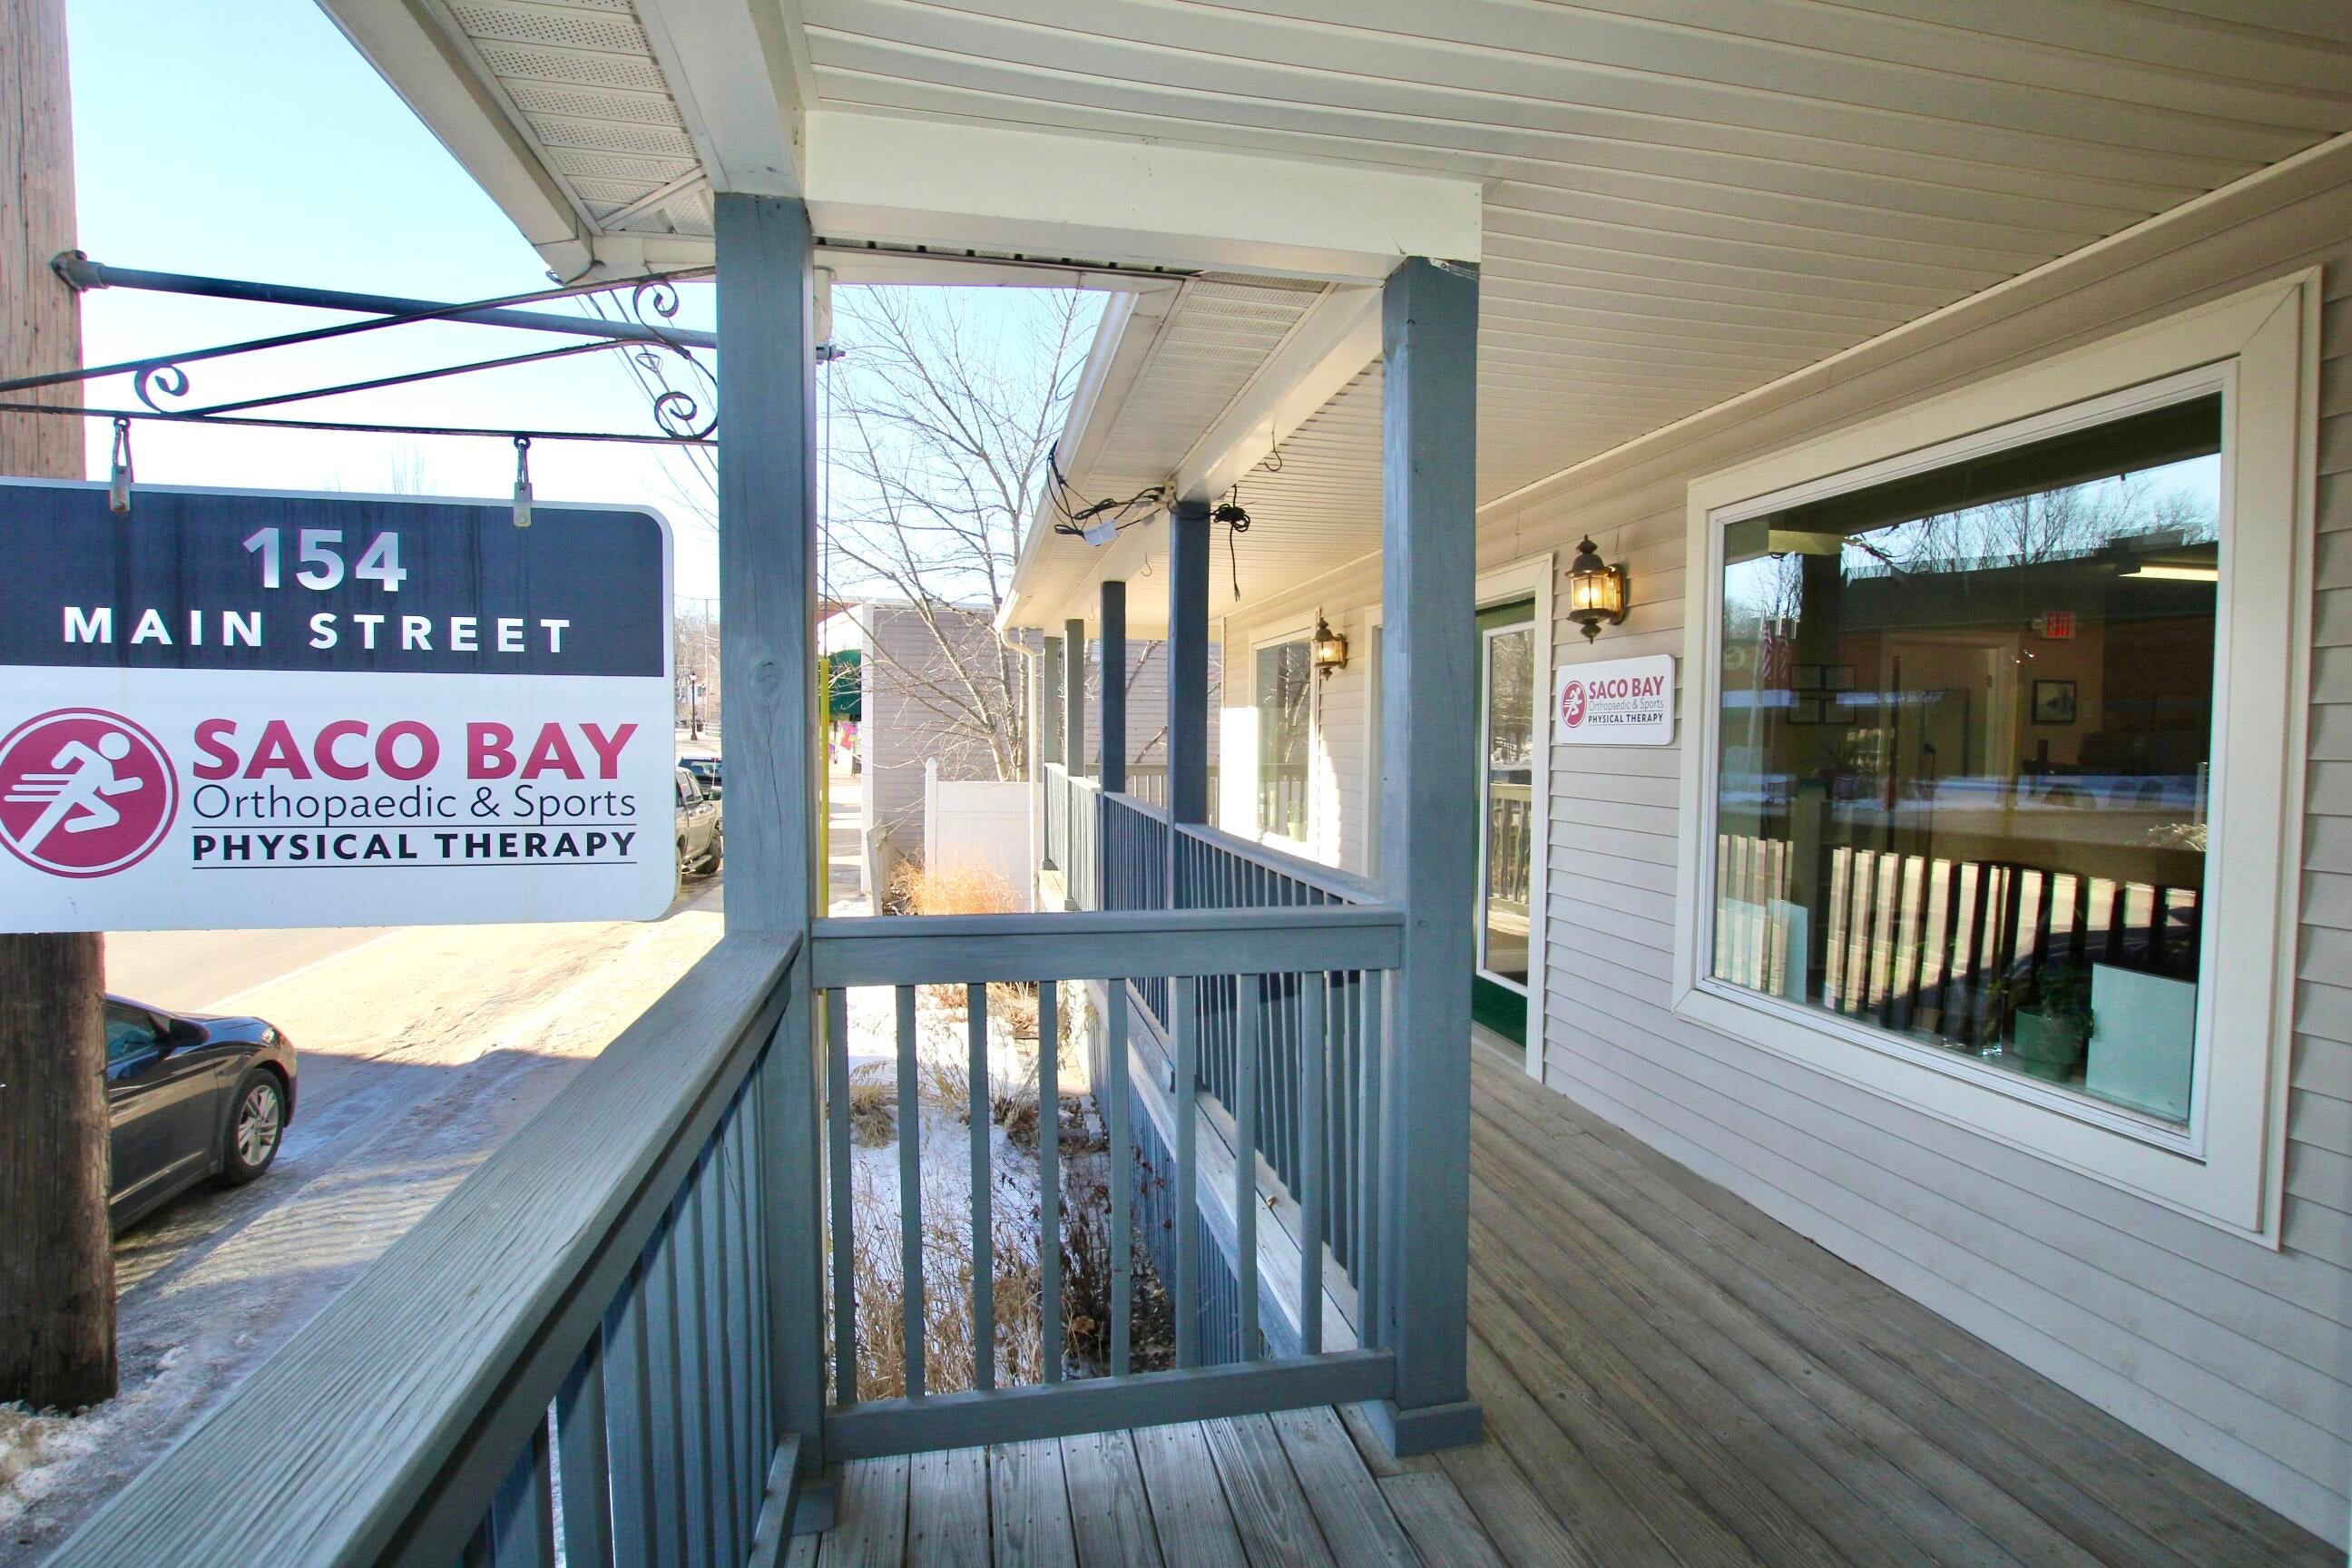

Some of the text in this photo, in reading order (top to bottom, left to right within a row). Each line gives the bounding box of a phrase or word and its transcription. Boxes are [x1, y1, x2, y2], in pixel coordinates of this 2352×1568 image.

[242, 527, 407, 592] 154
[64, 606, 570, 653] MAIN STREET
[2047, 612, 2075, 637] EXIT
[1589, 676, 1664, 700] SACO BAY
[1588, 713, 1663, 723] PHYSICAL THERAPY
[1589, 701, 1631, 711] Orthopaedic
[1641, 698, 1664, 711] Sports
[192, 719, 638, 780] SACO BAY
[193, 784, 635, 827] Orthopaedic & Sports
[193, 831, 636, 861] PHYSICAL THERAPY
